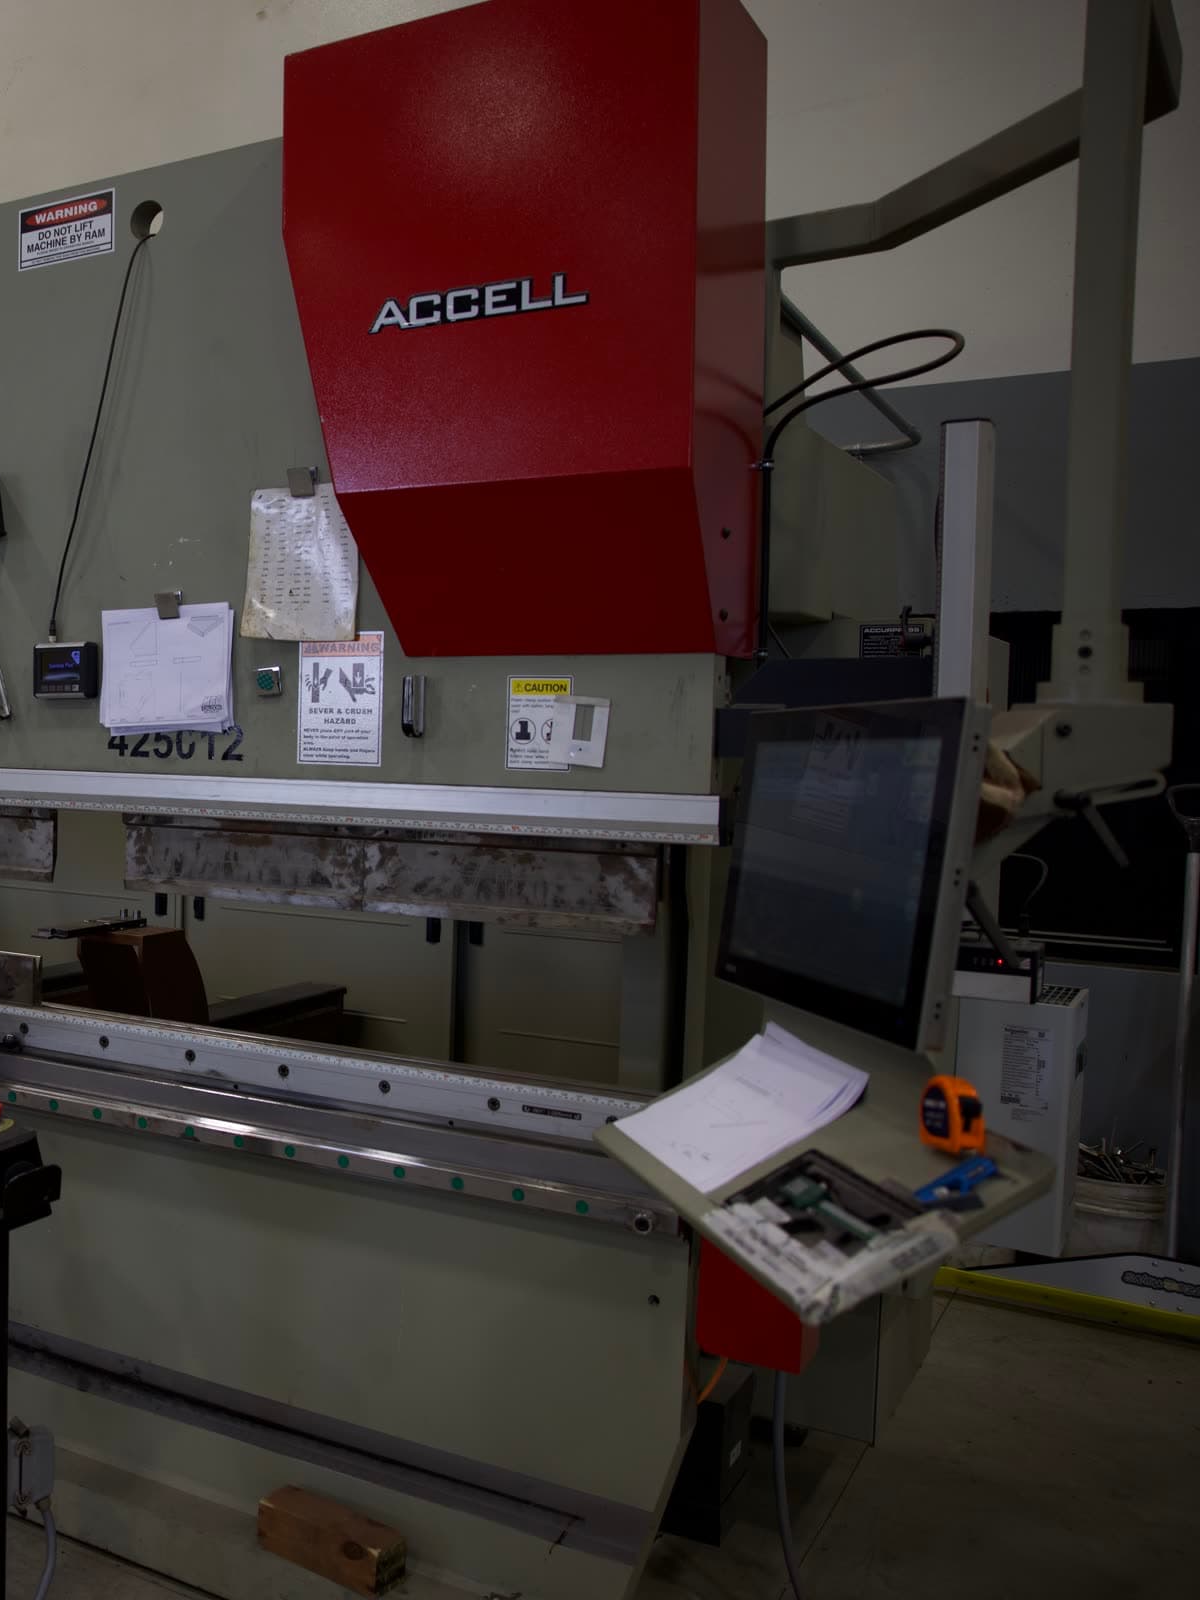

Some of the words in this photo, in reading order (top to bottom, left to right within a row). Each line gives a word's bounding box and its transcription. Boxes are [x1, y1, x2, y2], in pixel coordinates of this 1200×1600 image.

[35, 201, 97, 224] WARNING
[27, 236, 67, 253] MACHINE
[70, 233, 82, 244] BY
[85, 228, 105, 240] RAM
[38, 230, 51, 241] DO
[54, 225, 72, 237] NOT
[74, 220, 94, 233] LIFT
[368, 272, 589, 335] ACCELL
[319, 642, 381, 653] WARNING
[524, 683, 567, 693] CAUTION
